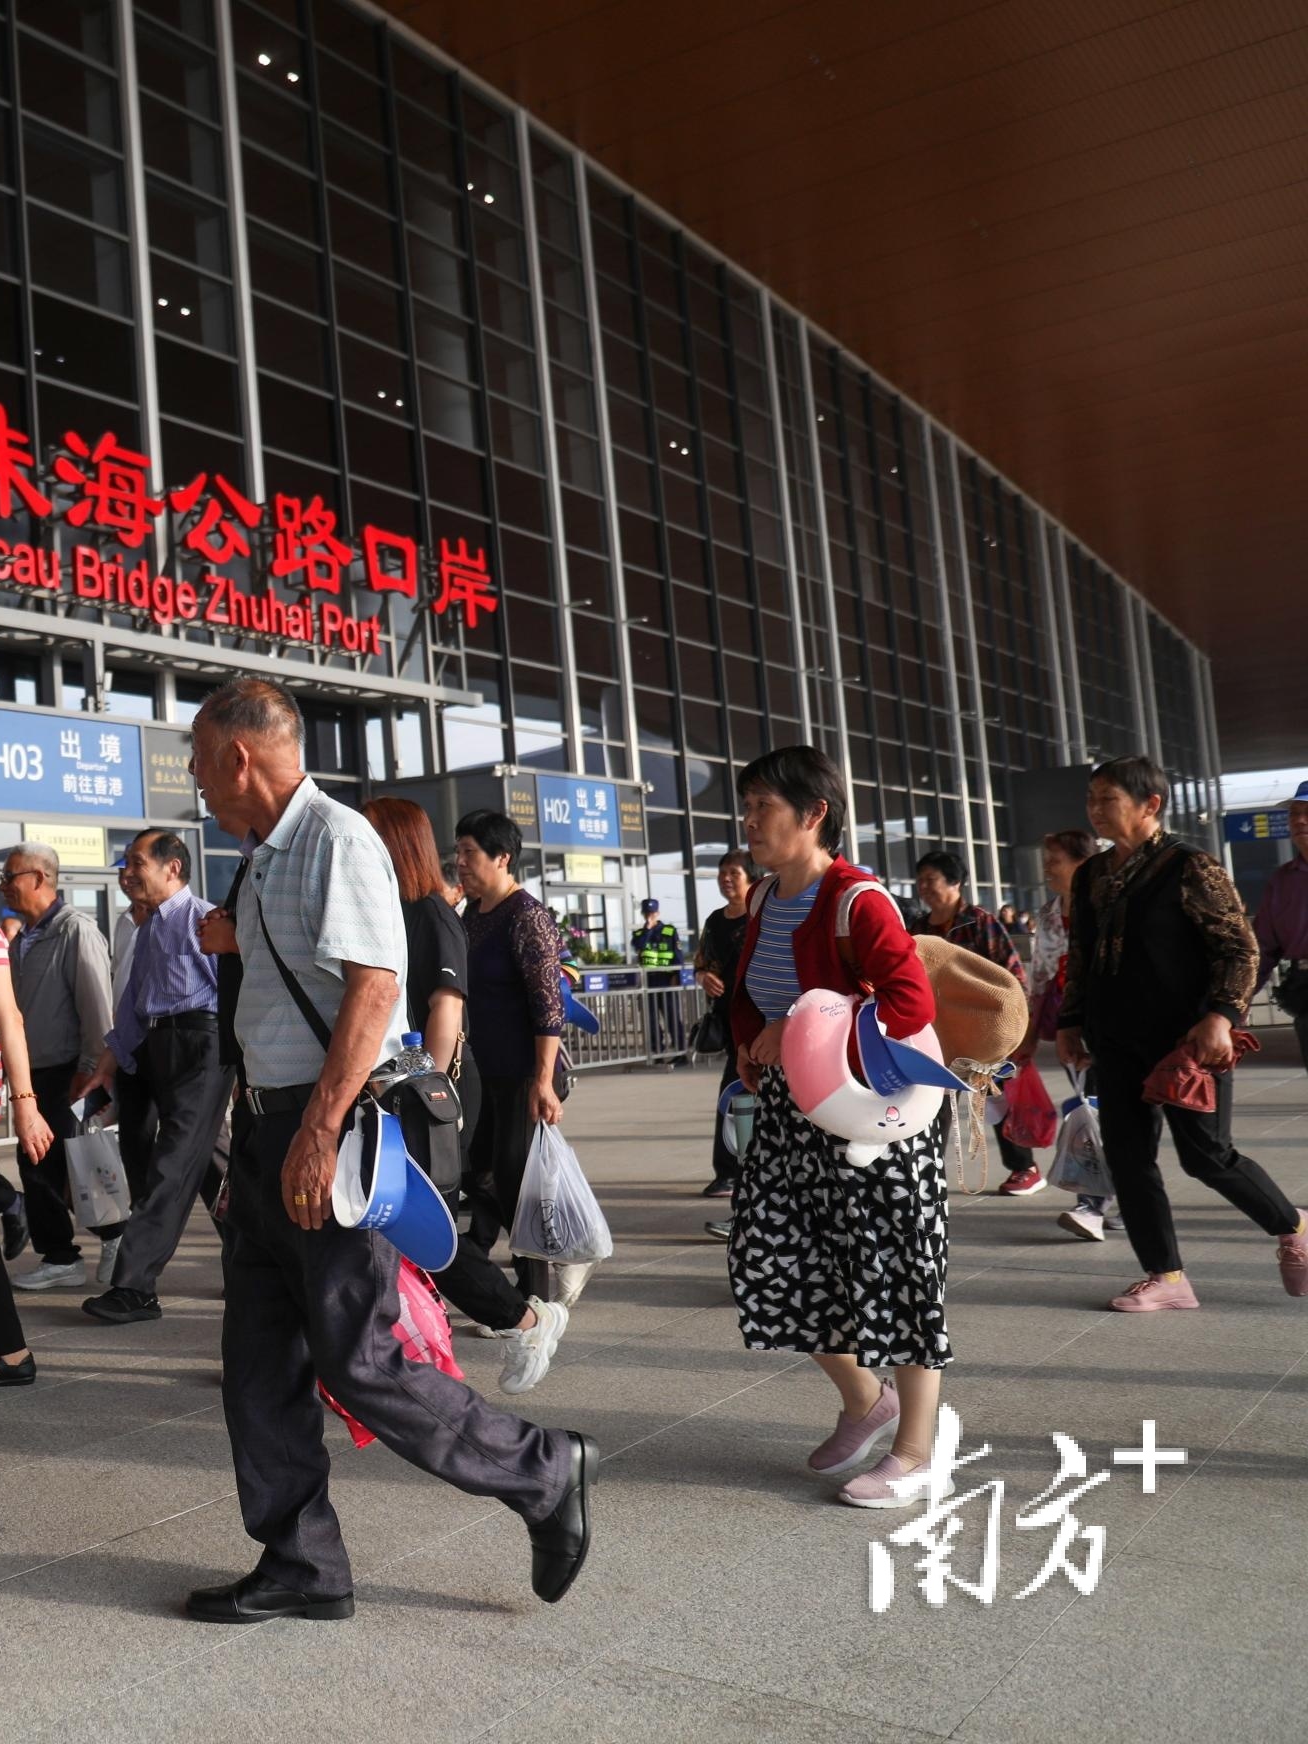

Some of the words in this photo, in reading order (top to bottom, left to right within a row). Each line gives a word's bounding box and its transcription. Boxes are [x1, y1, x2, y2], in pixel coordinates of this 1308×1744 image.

[73, 545, 198, 628] Bridge
[203, 573, 314, 643] Zhuhai
[321, 602, 383, 657] Port
[76, 760, 109, 773] Departure
[63, 773, 124, 798] 前往香港
[543, 796, 572, 825] H02
